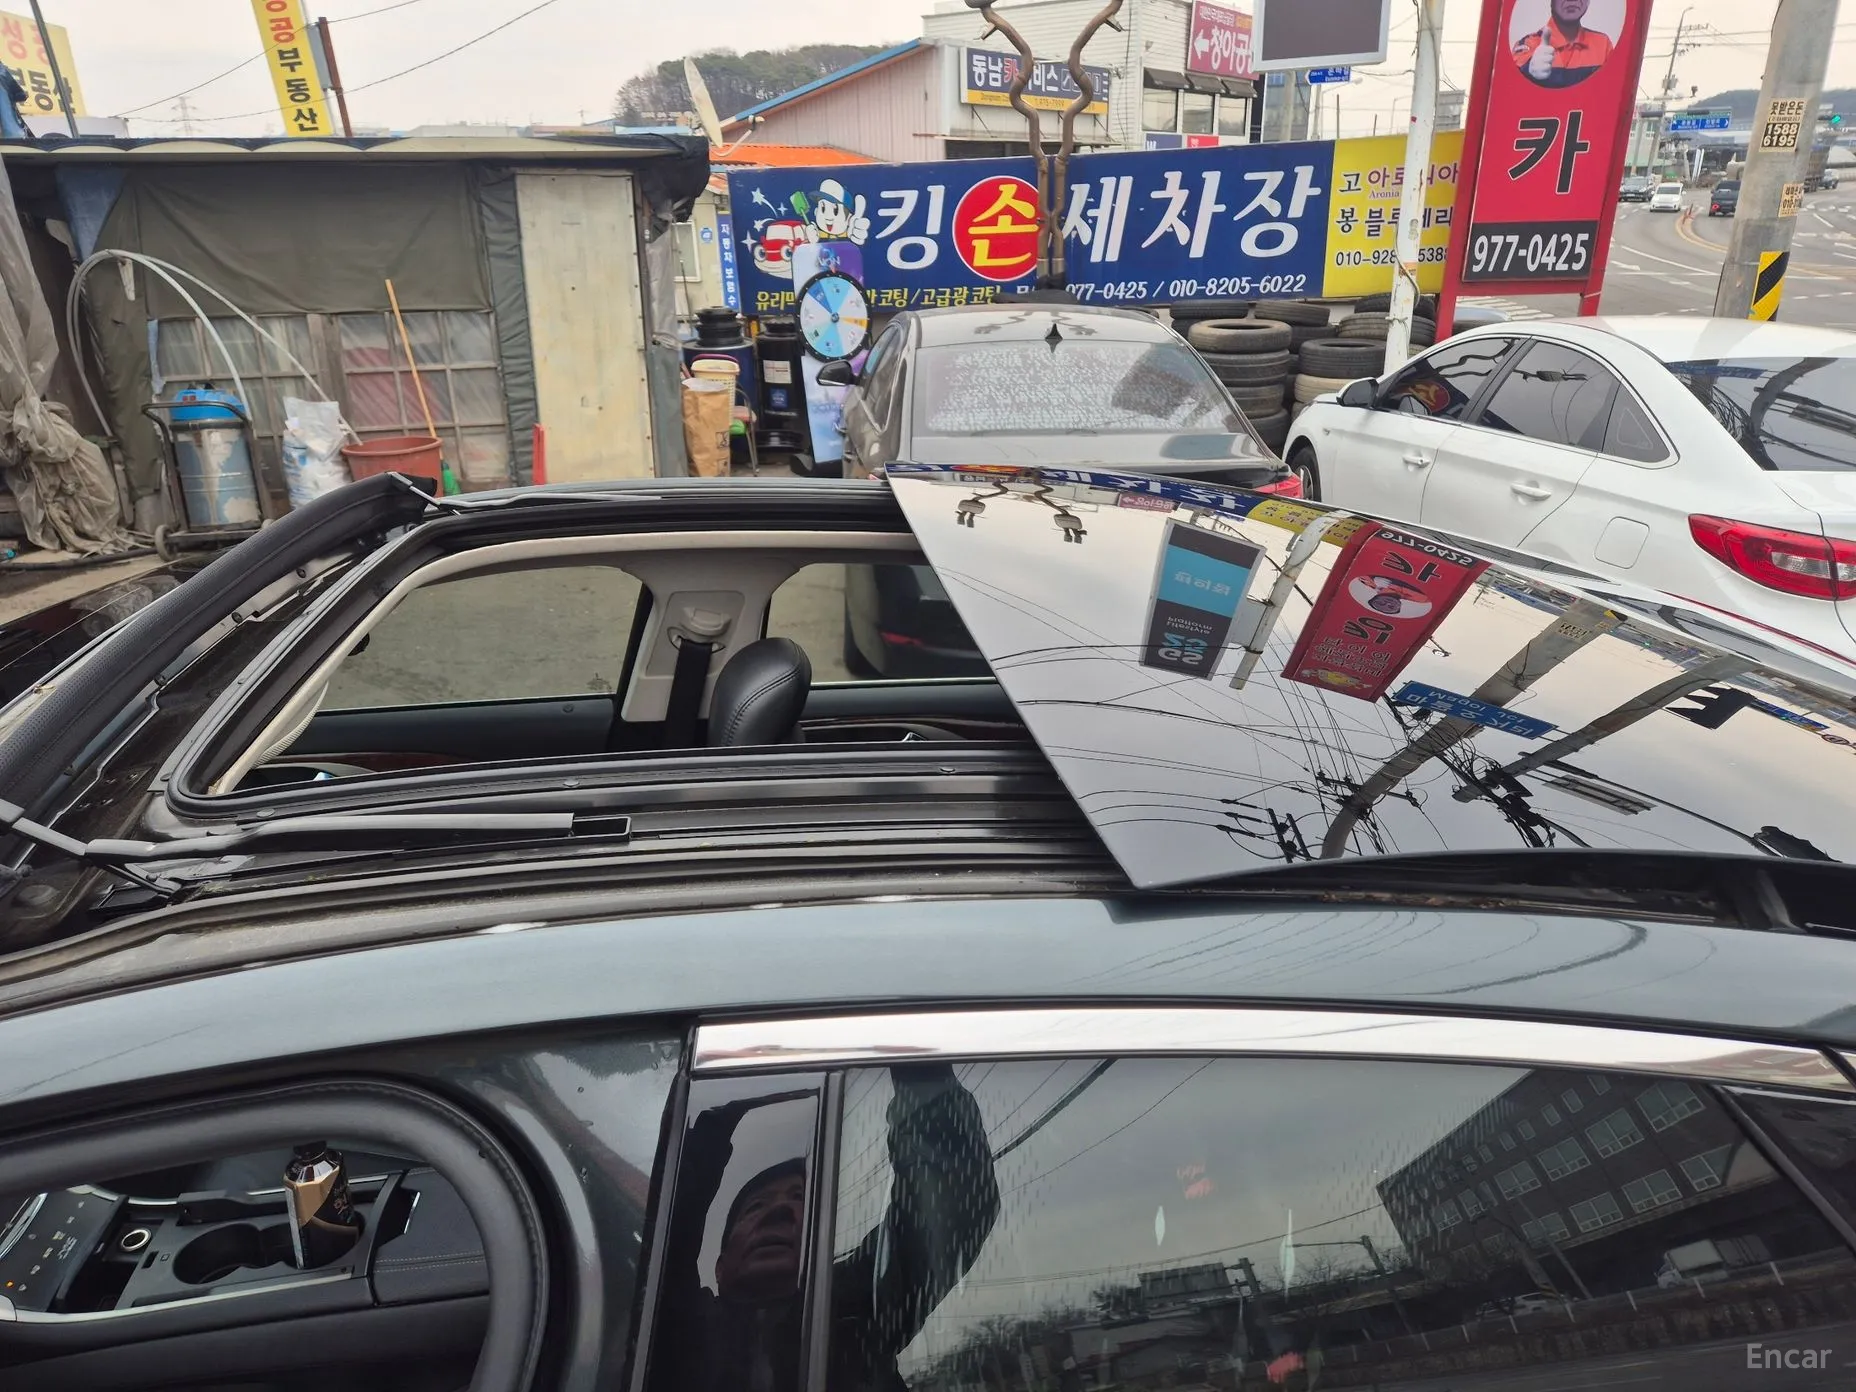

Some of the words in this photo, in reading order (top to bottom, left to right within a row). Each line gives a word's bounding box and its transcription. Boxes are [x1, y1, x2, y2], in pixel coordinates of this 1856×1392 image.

[1209, 25, 1254, 74] 청아공
[1763, 135, 1796, 147] 6195
[1767, 123, 1798, 135] 1588
[1507, 109, 1591, 195] 카
[1369, 189, 1400, 200] Aronia
[875, 184, 946, 270] 킹
[967, 183, 1040, 267] 손
[1061, 165, 1322, 263] 세차장
[1472, 233, 1589, 272] 977-0425
[1169, 274, 1307, 297] 010-8205-6022
